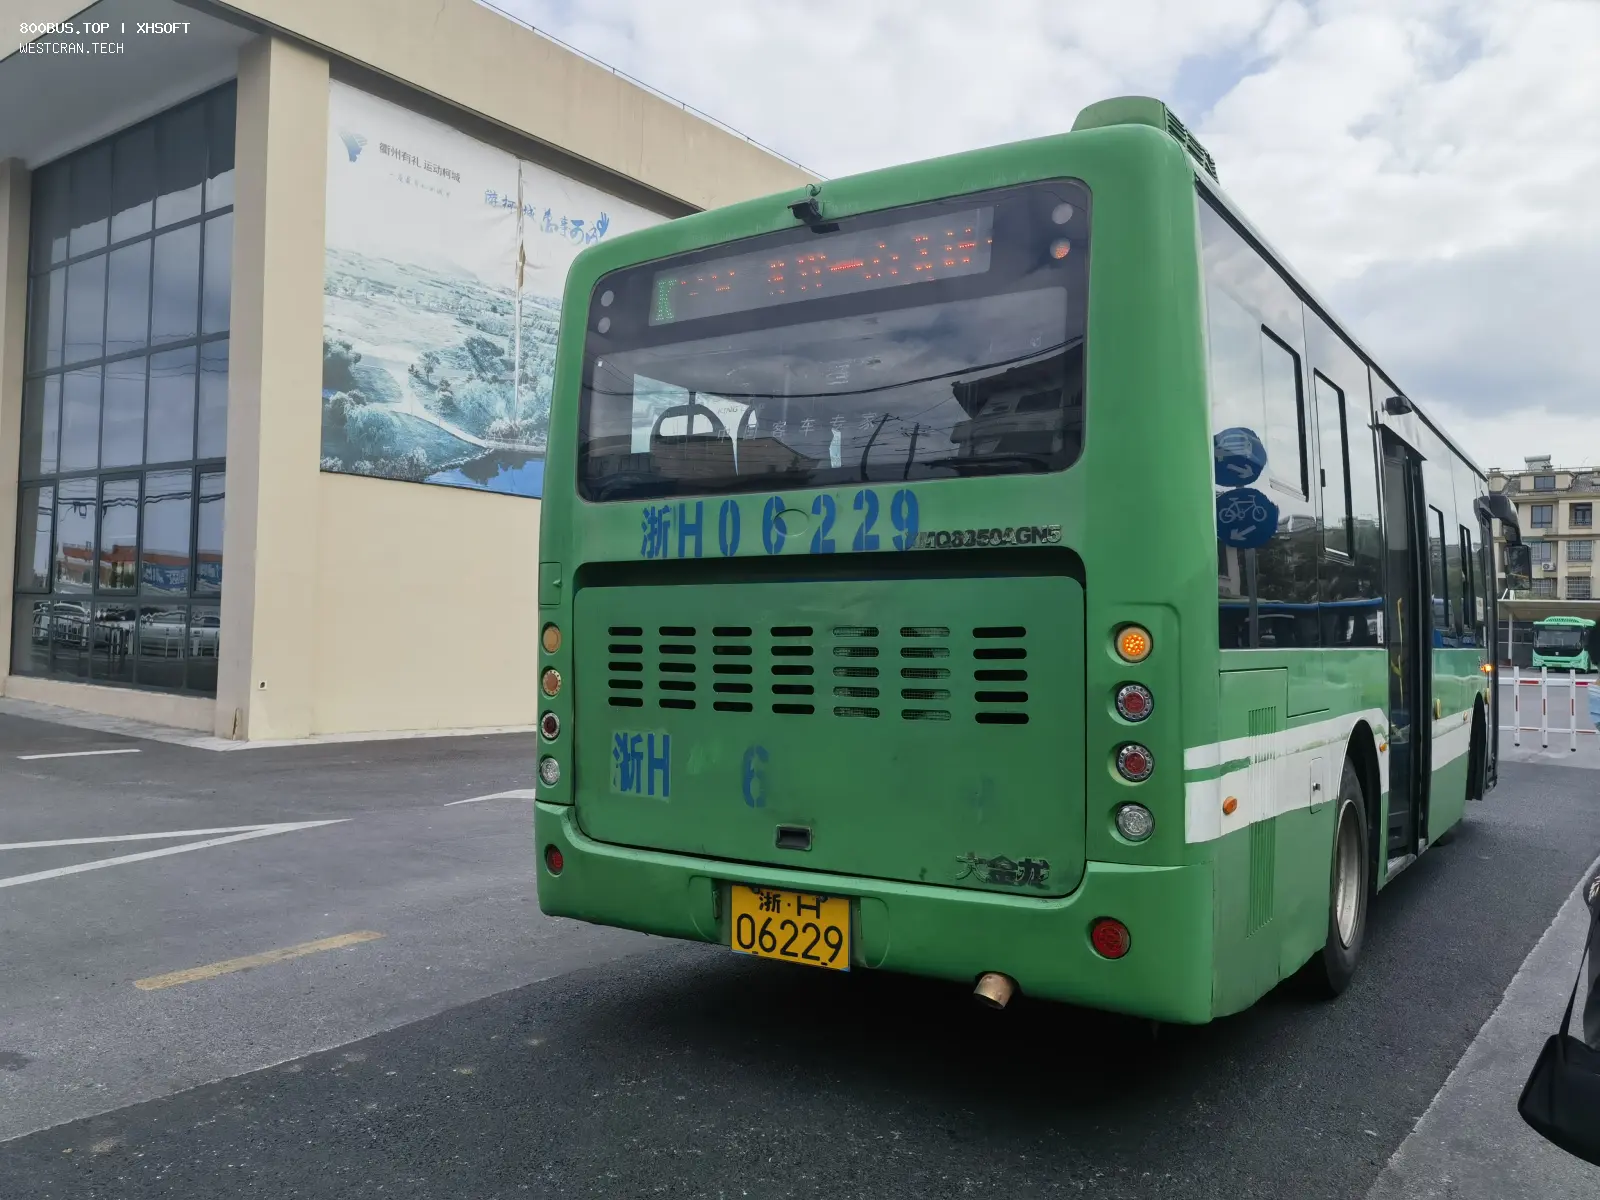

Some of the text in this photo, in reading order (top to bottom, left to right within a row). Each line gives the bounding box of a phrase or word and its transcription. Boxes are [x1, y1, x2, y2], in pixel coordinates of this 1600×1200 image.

[379, 142, 461, 184] 衢州有礼 运动柯城
[736, 912, 844, 963] 06229
